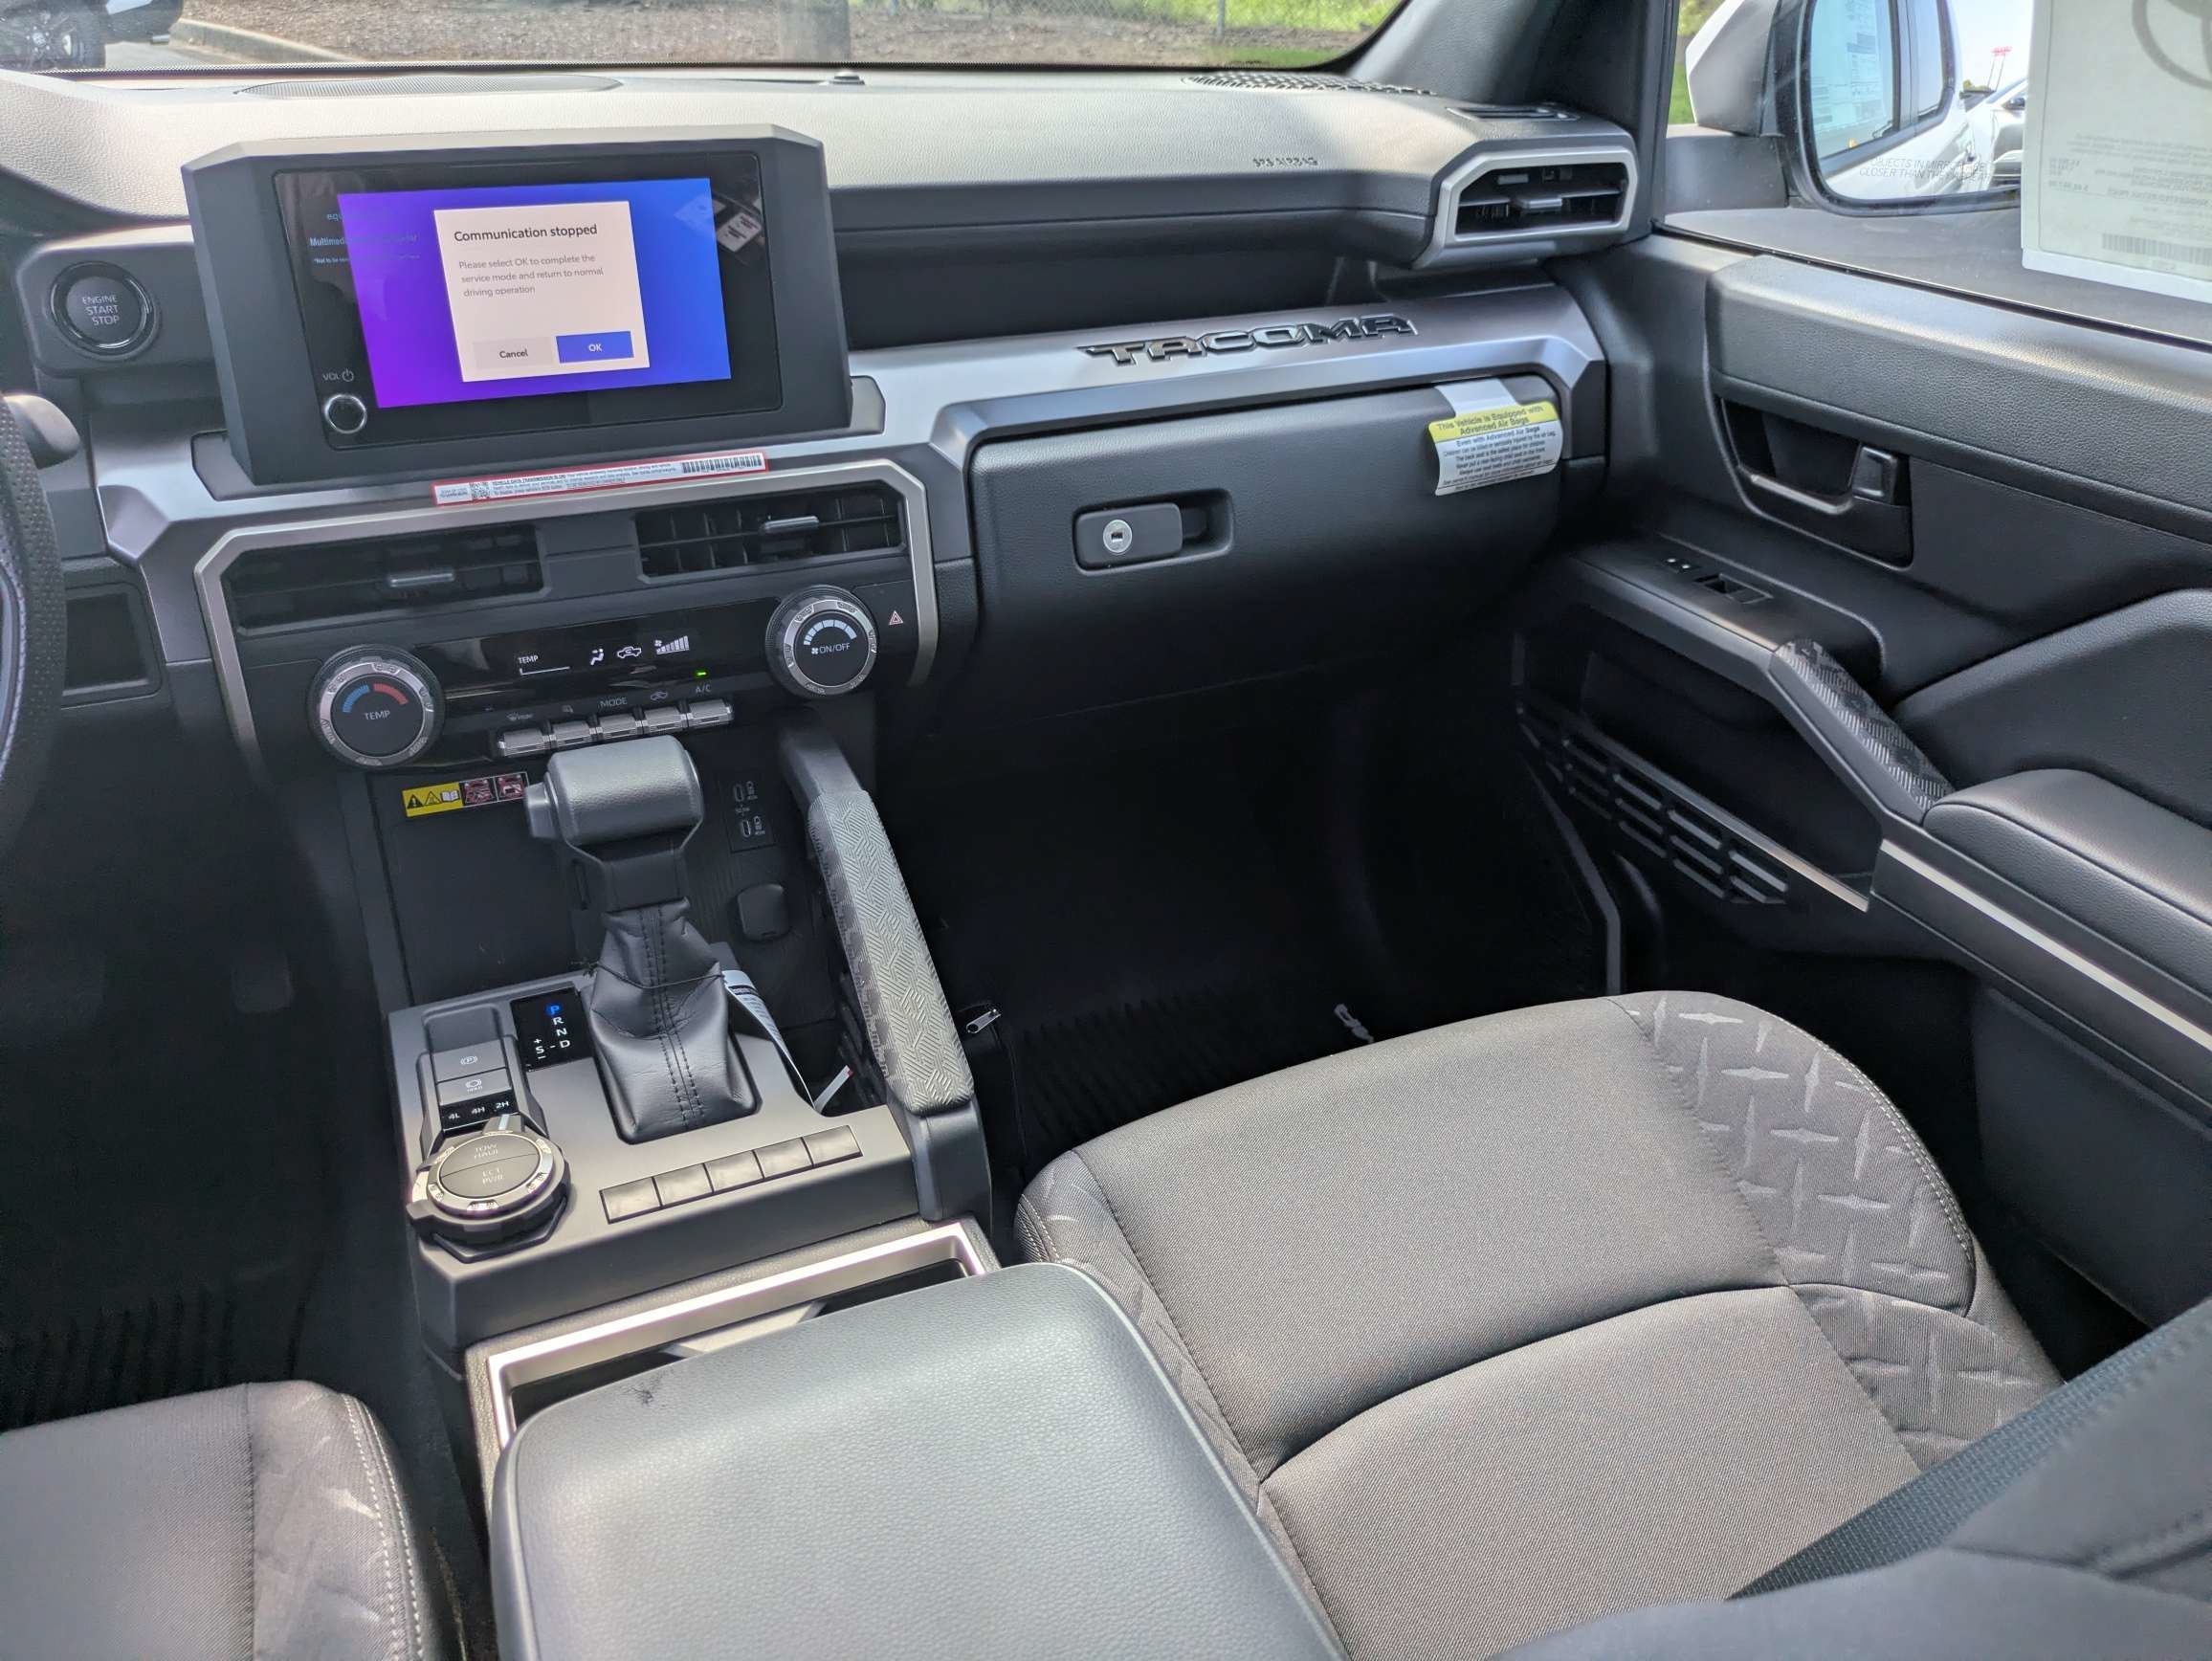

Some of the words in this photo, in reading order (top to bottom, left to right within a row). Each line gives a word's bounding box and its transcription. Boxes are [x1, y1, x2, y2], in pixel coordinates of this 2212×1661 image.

[1859, 167, 1897, 177] CLOSER
[453, 228, 548, 242] Communication
[550, 224, 598, 237] stopped
[459, 260, 487, 270] Please
[488, 259, 513, 268] select
[515, 257, 529, 266] OK
[530, 257, 540, 266] to
[541, 255, 580, 267] complete
[581, 254, 595, 263] the
[461, 274, 491, 283] service
[492, 272, 517, 281] mode
[519, 271, 535, 279] and
[537, 270, 563, 278] return
[563, 269, 572, 277] to
[574, 267, 604, 277] normal
[463, 288, 494, 298] driving
[495, 285, 535, 296] operation
[81, 294, 119, 305] ENGINE
[85, 304, 119, 316] START
[91, 315, 120, 326] STOP
[1077, 315, 1418, 365] TACOMA
[588, 343, 603, 352] OK
[498, 348, 529, 359] Cancel
[321, 372, 342, 381] VOL
[1438, 421, 1454, 431] This
[1456, 417, 1482, 428] Vehicle
[1492, 409, 1527, 421] Equipped
[1528, 405, 1544, 414] with
[1460, 424, 1496, 435] Advanced
[1498, 420, 1509, 429] Air
[819, 642, 850, 654] ON/OFF
[518, 654, 540, 665] TEMP
[695, 682, 712, 695] A/C
[600, 697, 628, 708] MODE
[364, 710, 391, 720] TEMP
[549, 1005, 561, 1015] P
[552, 1016, 564, 1026] R
[556, 1027, 567, 1037] N
[535, 1045, 545, 1054] S
[559, 1039, 571, 1049] D
[472, 1106, 485, 1115] 4H
[496, 1100, 509, 1109] 2H
[476, 1143, 498, 1152] TOW
